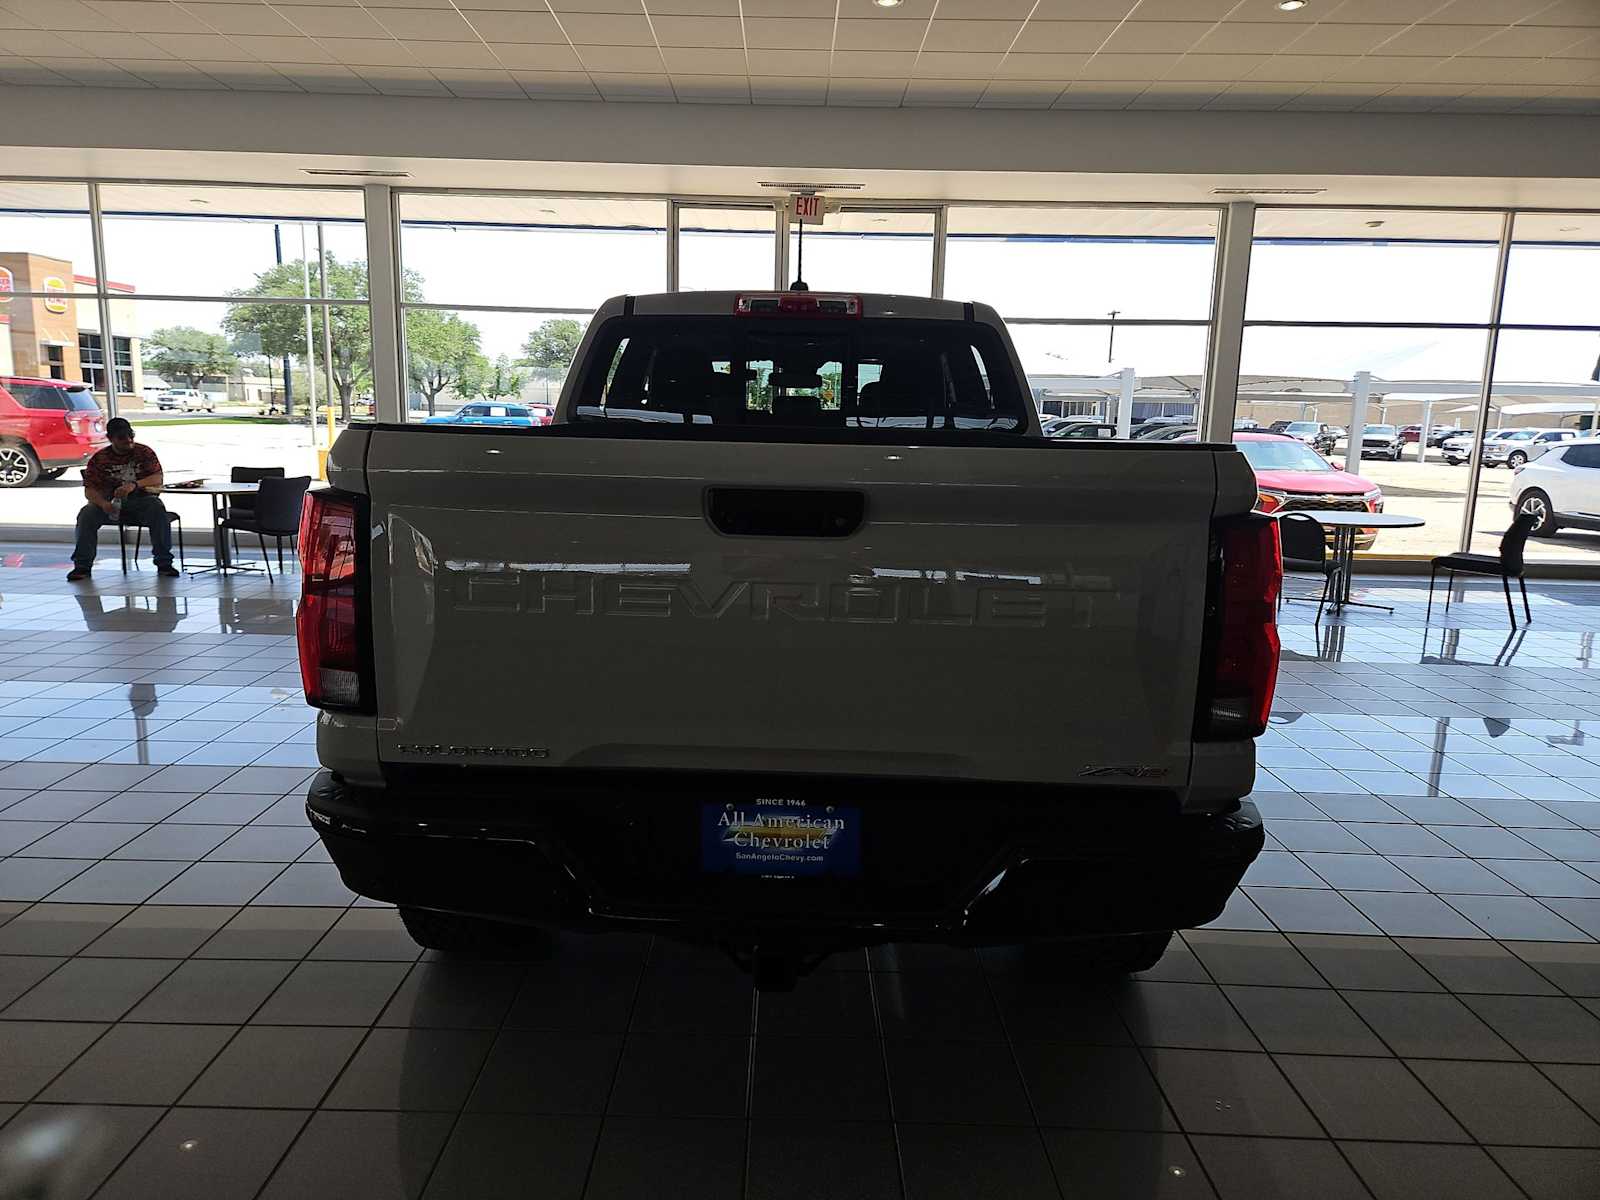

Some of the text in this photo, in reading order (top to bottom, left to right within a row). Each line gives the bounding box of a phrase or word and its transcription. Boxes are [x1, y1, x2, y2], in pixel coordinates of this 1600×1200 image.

[796, 197, 820, 216] EXIT
[452, 572, 1119, 628] CHEVROLET
[756, 798, 784, 807] SINCE
[717, 811, 845, 830] All American
[734, 832, 832, 849] Chevrolet
[736, 852, 824, 863] SanAngeloChevy.com
